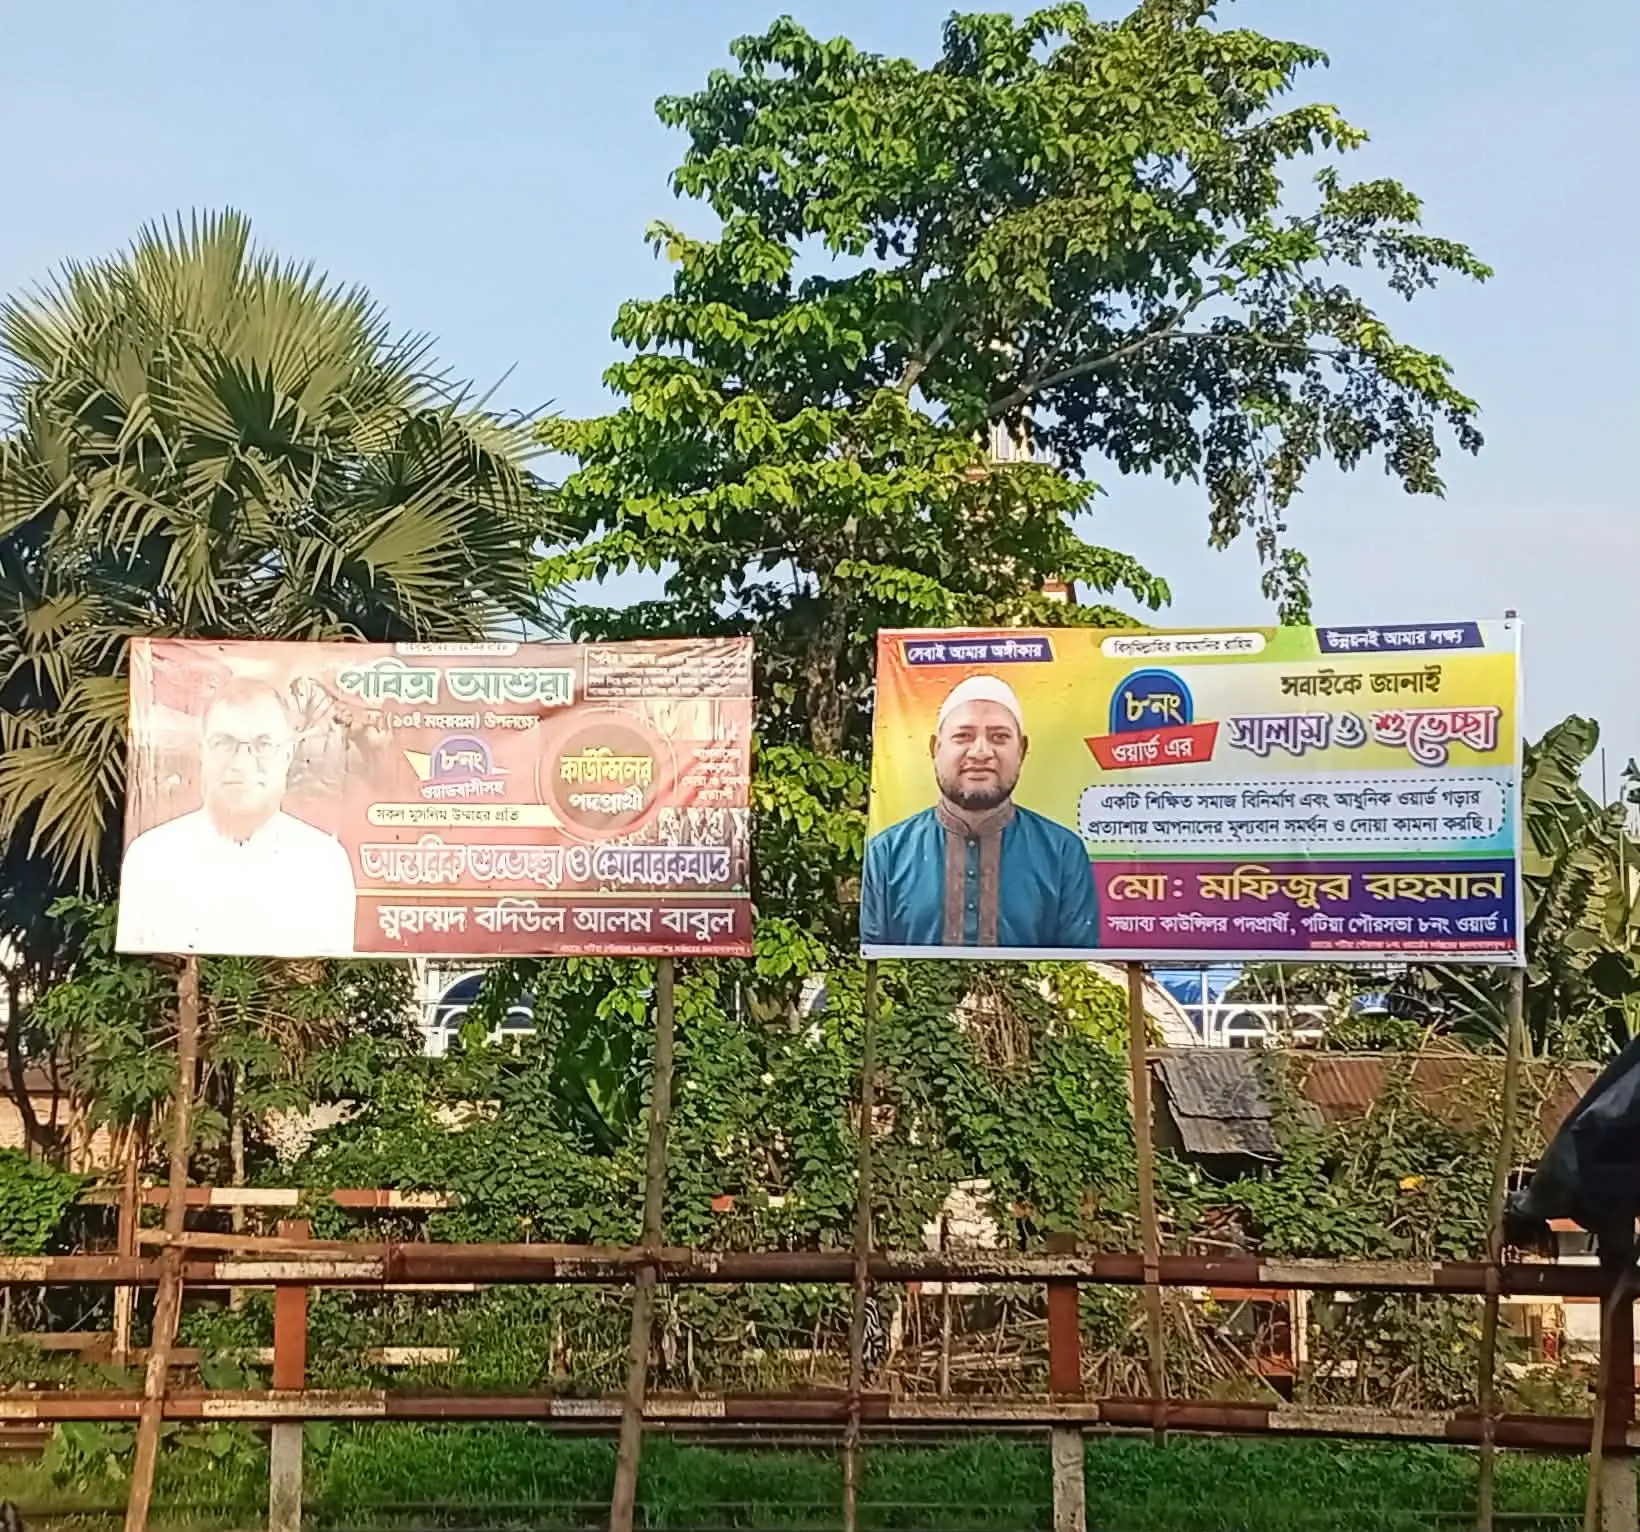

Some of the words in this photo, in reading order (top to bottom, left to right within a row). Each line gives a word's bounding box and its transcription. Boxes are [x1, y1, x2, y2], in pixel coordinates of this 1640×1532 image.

[908, 643, 947, 661] সেবাই
[948, 645, 988, 659] আমার
[990, 640, 1043, 658] অঙ্গীকার
[1326, 629, 1381, 649] উন্নয়নই
[1383, 630, 1425, 646] আমার
[337, 659, 440, 704] পবিত্র
[446, 668, 575, 706] আশুরা
[1280, 669, 1362, 696] সবাইকে
[1369, 665, 1442, 694] জানাই
[1124, 691, 1184, 724] ৮নং
[1111, 734, 1161, 763] ওয়ার্ড
[1164, 736, 1194, 758] এর
[1226, 712, 1333, 757] সালাম
[1332, 712, 1366, 748] ও
[1371, 705, 1502, 768] শুভেচ্ছা
[440, 749, 486, 773] ৮নং
[559, 746, 654, 786] কাউন্সিলর
[1100, 791, 1141, 810] একটি
[1144, 791, 1194, 810] শিক্ষিত
[1196, 795, 1238, 809] সমাজ
[1299, 793, 1331, 809] এবং
[1333, 788, 1392, 810] আধুনিক
[1397, 787, 1438, 807] ওয়ার্ড
[1441, 790, 1482, 808] গড়ার
[376, 808, 405, 821] সকল
[408, 807, 448, 822] মুসলিম
[495, 807, 520, 821] প্রতি
[1087, 820, 1149, 835] প্রত্যাশায়
[1151, 820, 1224, 835] আপনাদের
[1227, 819, 1280, 839] মূল্যবান
[1283, 814, 1328, 833] সমর্থন
[1332, 819, 1346, 832] ও
[1350, 817, 1388, 832] দোয়া
[1392, 817, 1438, 832] কামনা
[360, 834, 466, 884] আন্তরিক
[467, 845, 563, 888] শুভেচ্ছা
[566, 845, 591, 882] ও
[593, 845, 731, 885] মোবারকবাদ
[1196, 864, 1352, 910] মফিজুর
[1361, 872, 1505, 902] রহমান
[378, 904, 468, 940] মুহাম্মদ
[474, 898, 567, 934] বদিউল
[572, 907, 653, 933] আলম
[660, 908, 735, 941] বাবুল
[1300, 912, 1345, 933] পটিয়া
[1348, 913, 1414, 933] পৌরসভা
[1417, 917, 1452, 934] ৮নং
